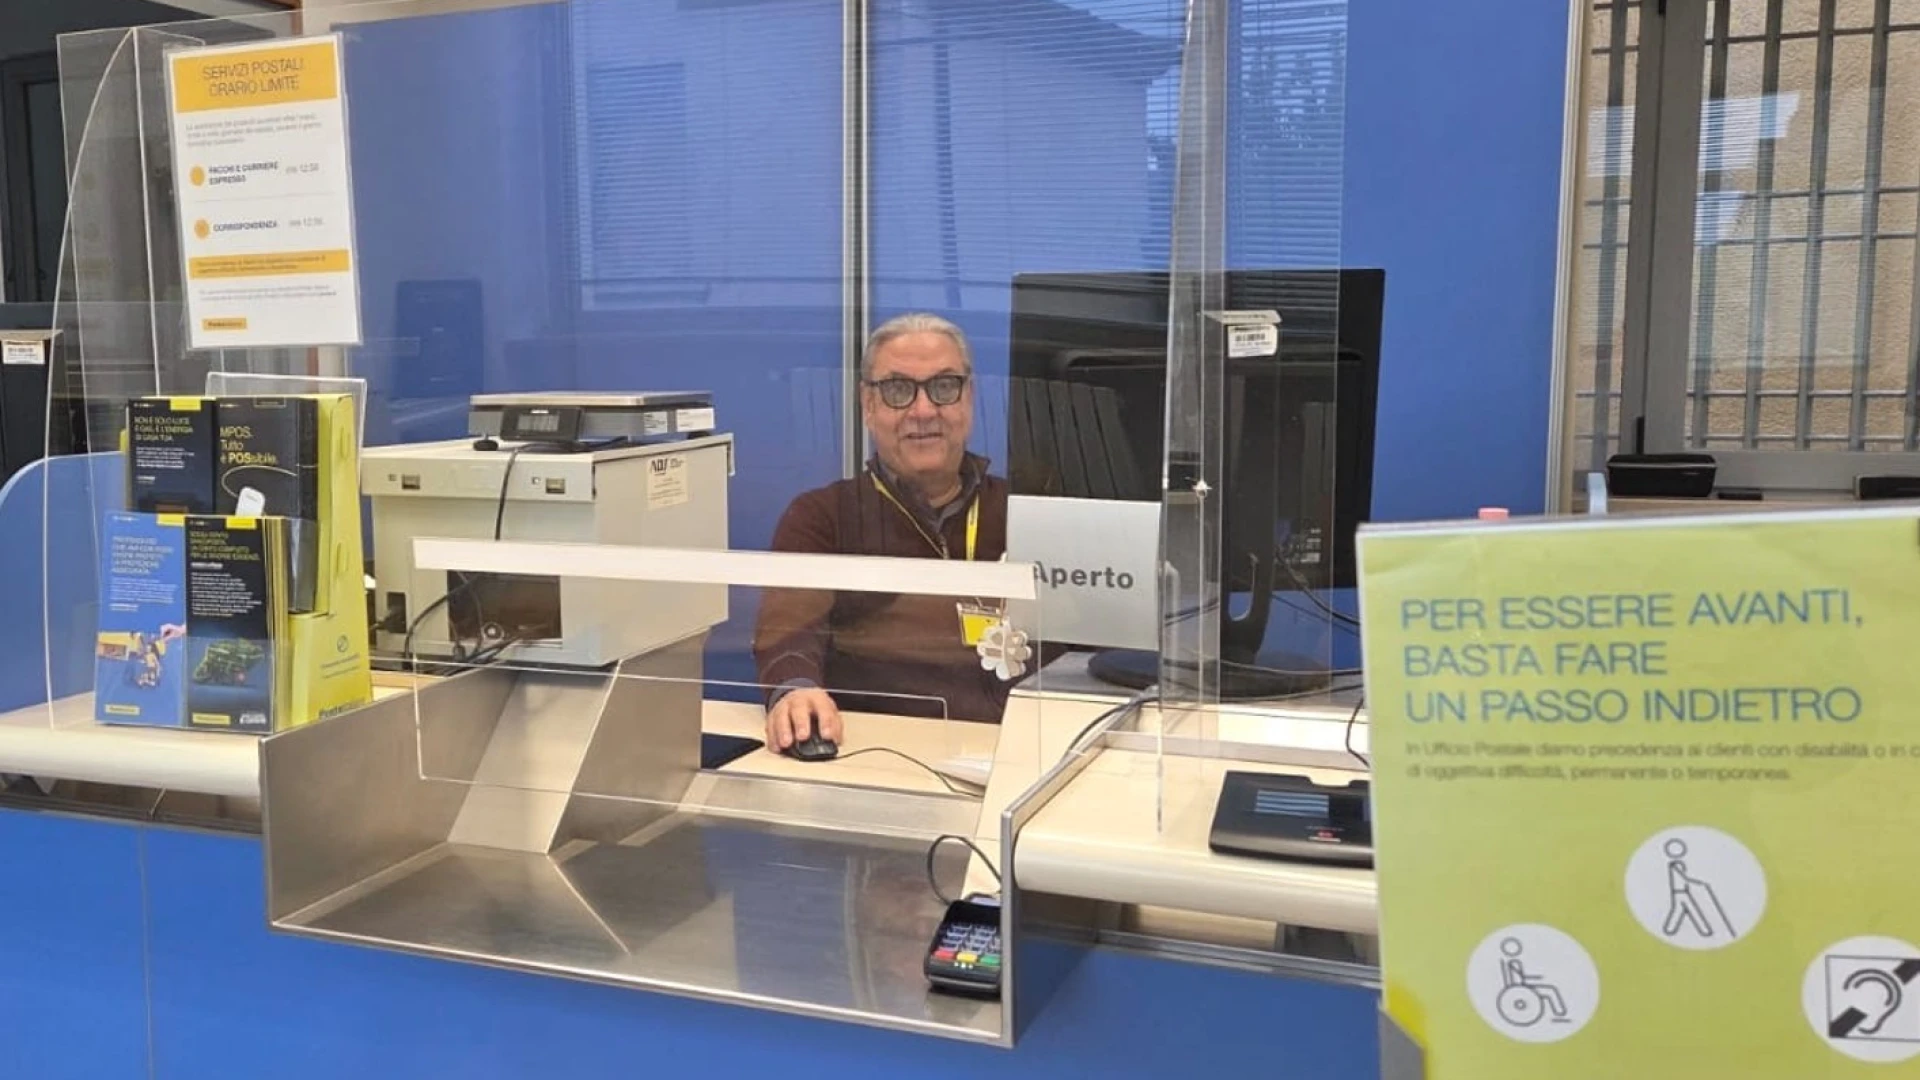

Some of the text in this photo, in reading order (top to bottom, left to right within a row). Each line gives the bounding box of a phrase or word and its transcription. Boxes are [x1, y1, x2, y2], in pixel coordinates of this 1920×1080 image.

[203, 57, 304, 80] SERVIZI POSTALI
[209, 75, 300, 96] ORARIO LIMITE
[1033, 560, 1134, 590] Aperto
[1401, 589, 1863, 631] PER ESSERE AVANTI,
[1404, 640, 1668, 678] BASTA FARE
[1405, 685, 1862, 723] UN PASSO INDIETRO
[1588, 743, 1683, 758] precedenza
[1757, 745, 1790, 757] con
